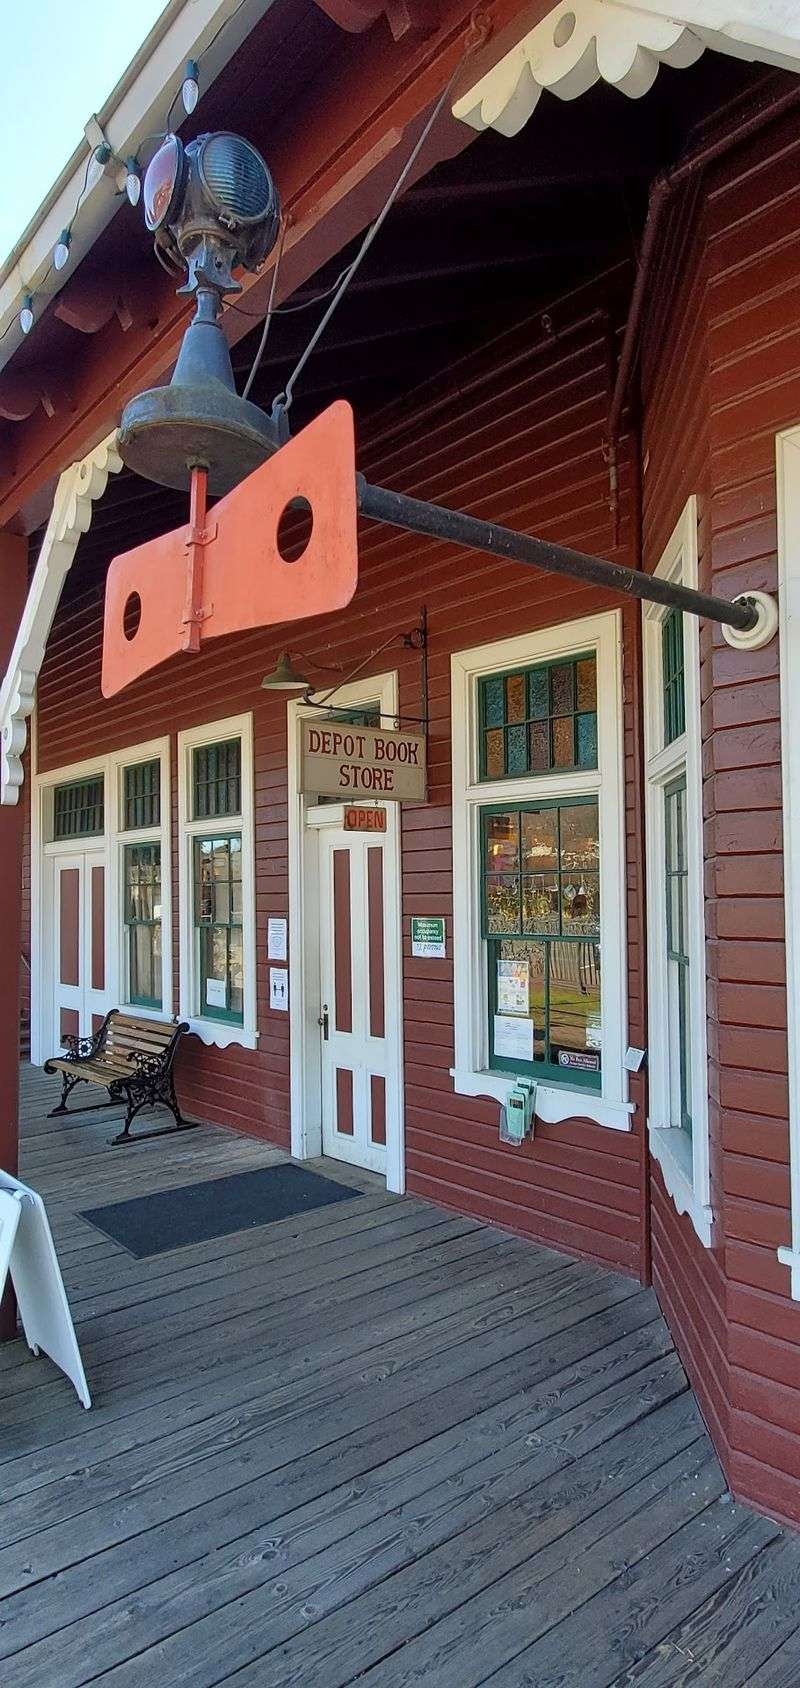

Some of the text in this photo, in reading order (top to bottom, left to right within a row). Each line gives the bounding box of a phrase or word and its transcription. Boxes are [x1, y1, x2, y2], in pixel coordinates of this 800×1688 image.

[308, 730, 419, 765] DEPOT BOOK
[339, 764, 394, 791] STORE
[346, 809, 384, 829] OPEN
